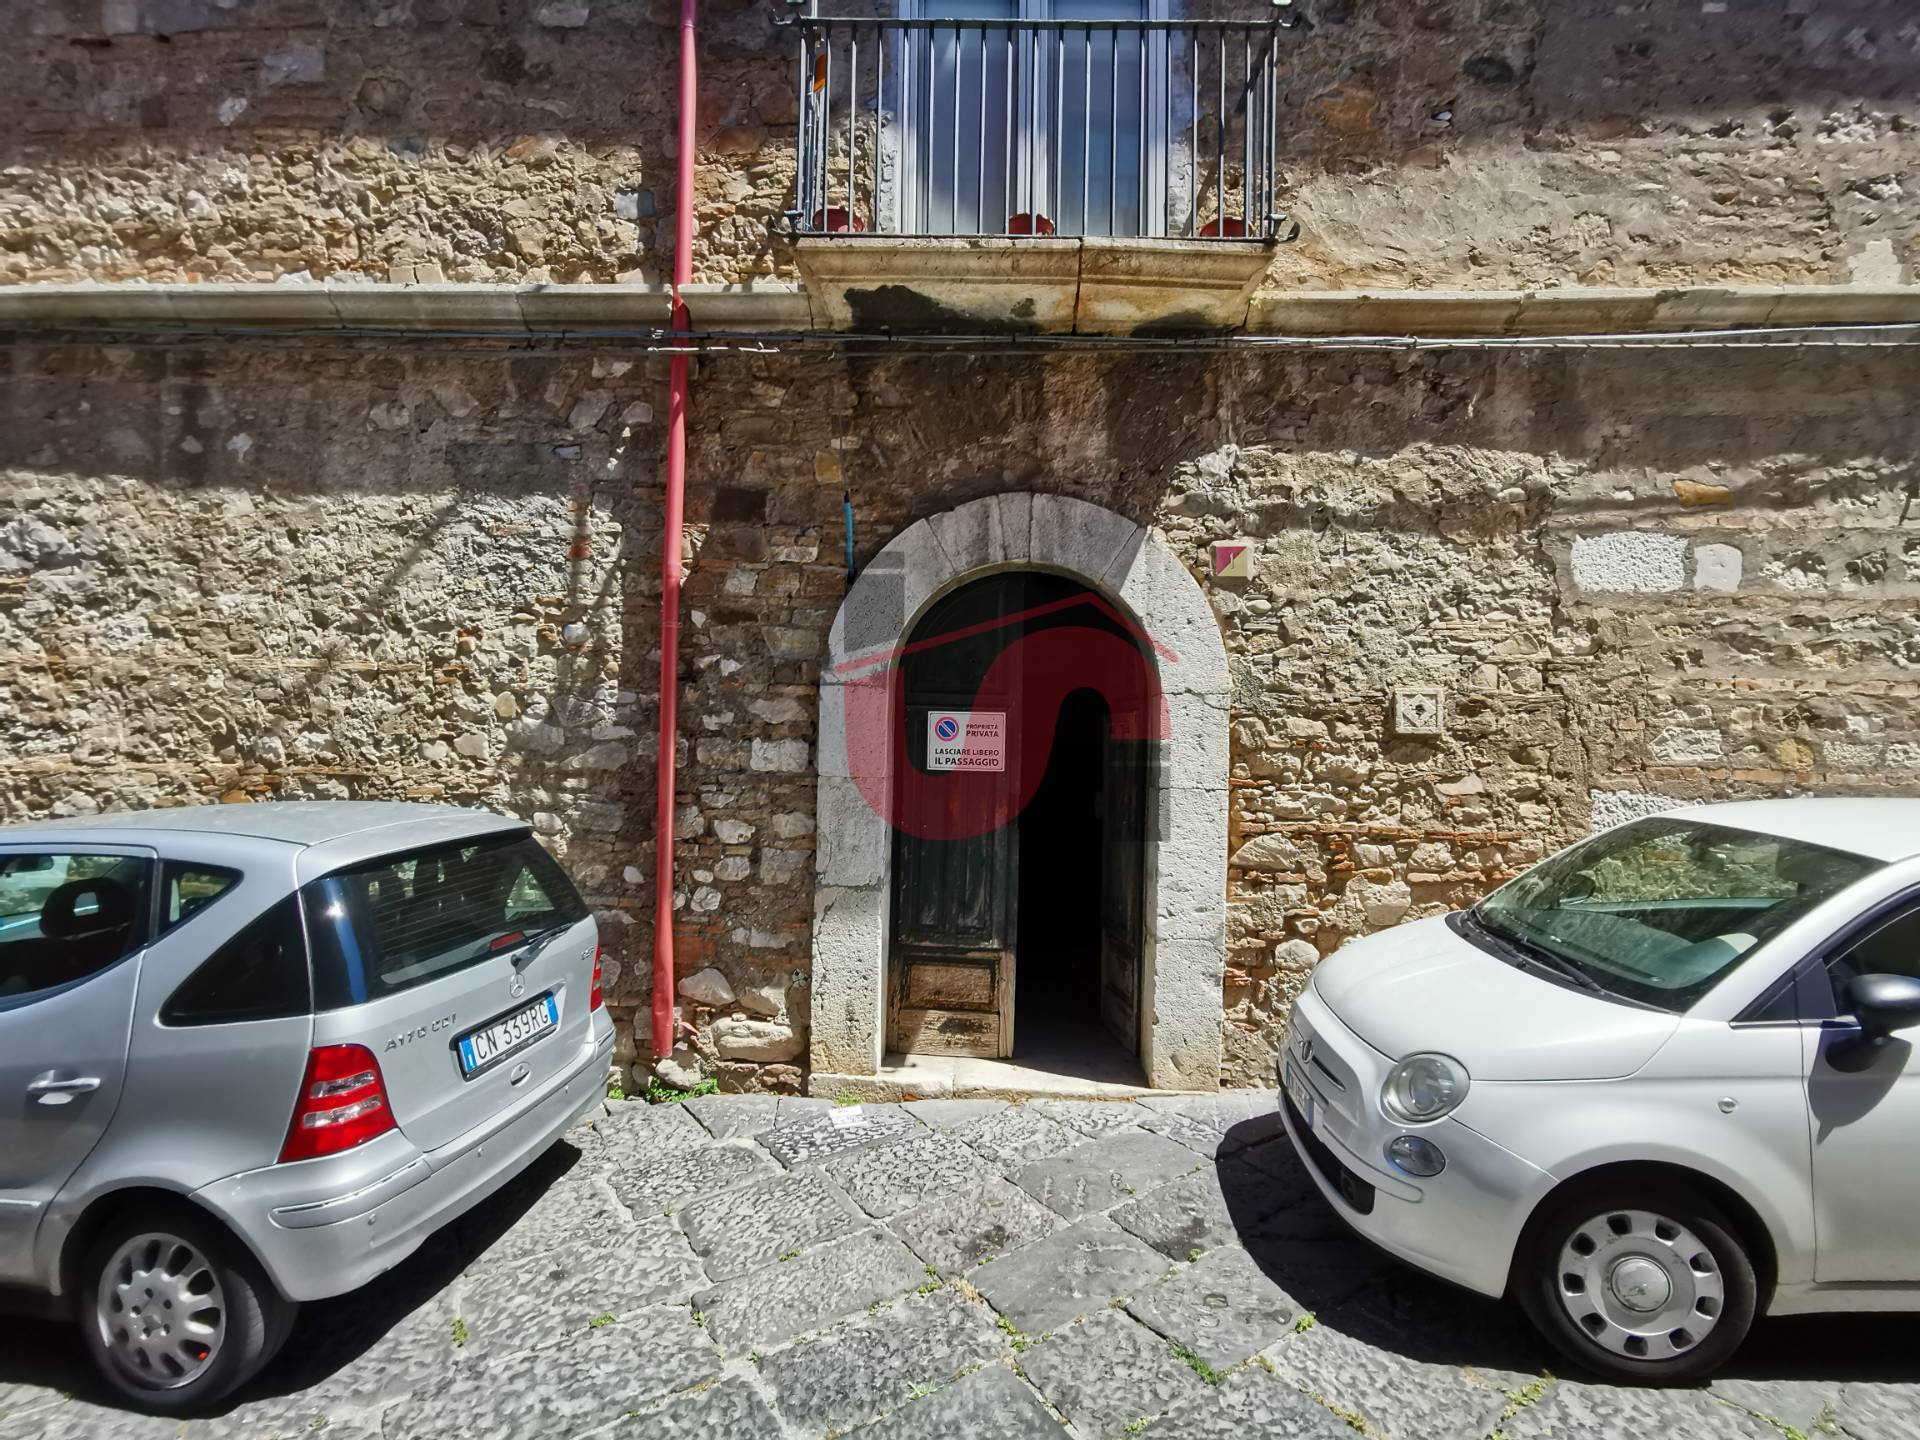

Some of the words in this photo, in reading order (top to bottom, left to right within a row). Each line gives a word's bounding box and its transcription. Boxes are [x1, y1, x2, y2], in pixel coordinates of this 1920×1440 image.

[935, 748, 971, 756] LASCIARE
[934, 757, 943, 765] IL
[945, 757, 999, 766] PASSAGGIO
[475, 1028, 499, 1060] CN
[503, 1001, 549, 1045] 339RG
